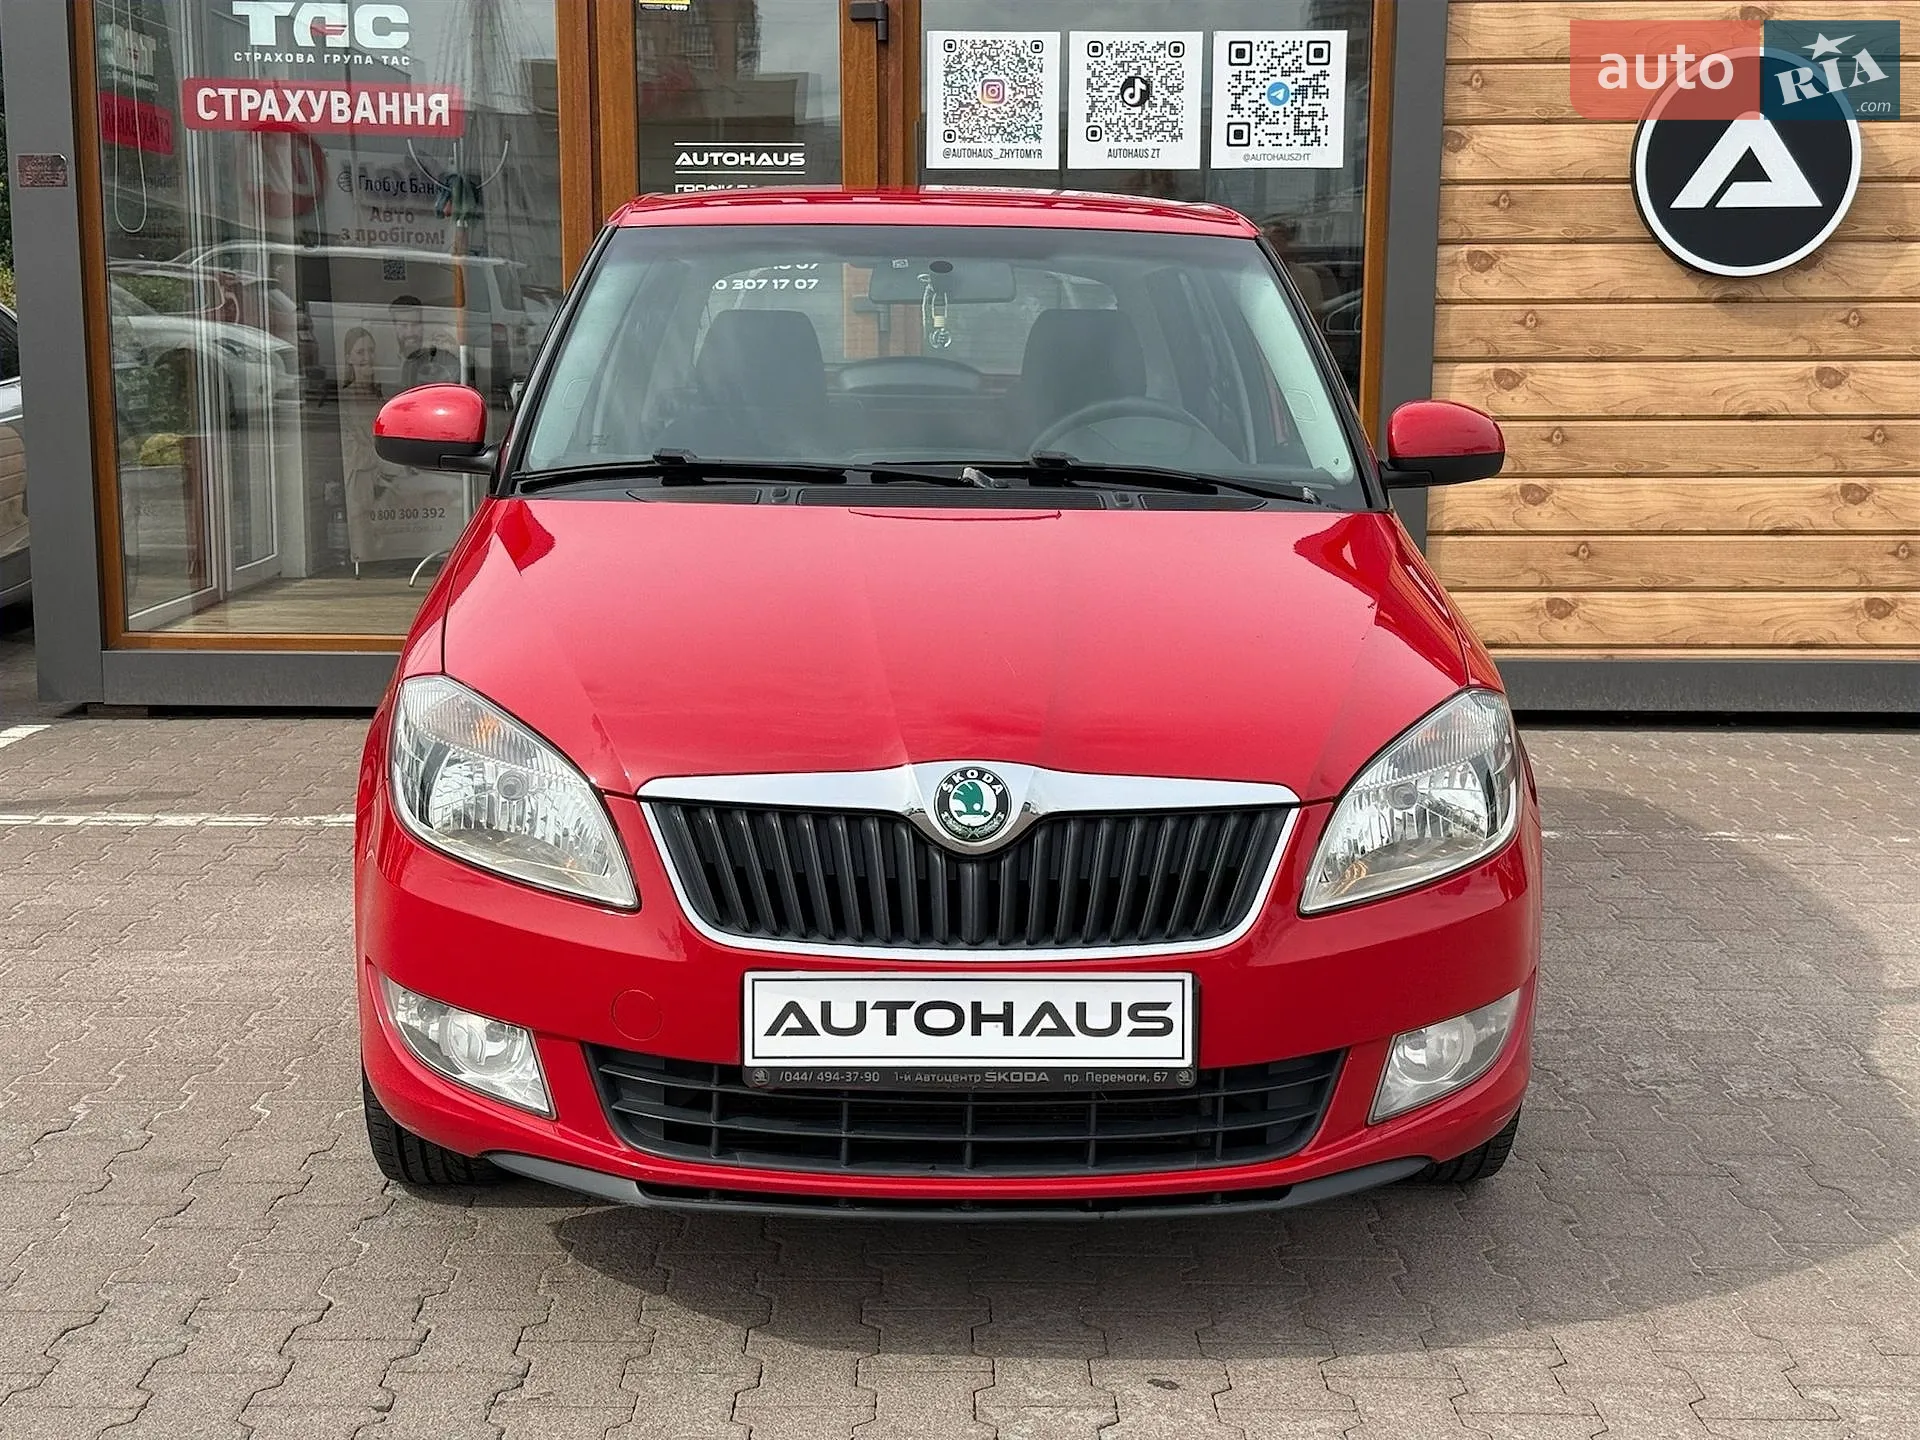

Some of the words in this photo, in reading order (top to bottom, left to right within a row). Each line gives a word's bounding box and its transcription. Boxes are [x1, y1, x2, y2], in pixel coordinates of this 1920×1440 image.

[234, 51, 316, 64] СТРАХОВА
[323, 55, 374, 65] ГРУПА
[381, 55, 411, 66] ТАС
[196, 87, 450, 126] СТРАХУВАННЯ
[675, 152, 806, 166] AUTOHAUS
[943, 148, 1043, 160] @AUTOHAUS_ZHYTOMYR
[1107, 148, 1149, 159] AUTOHAUS
[1150, 148, 1161, 159] ZT
[358, 174, 407, 196] Глобус
[370, 206, 415, 223] Авто
[355, 227, 445, 245] пробігом!
[732, 279, 768, 290] 307
[772, 279, 790, 290] 17
[794, 279, 819, 290] 07
[378, 509, 396, 520] 800
[399, 508, 419, 520] 300
[422, 507, 446, 519] 392
[763, 1000, 1174, 1037] AUTOHAUS
[779, 1071, 813, 1082] /044/
[817, 1071, 880, 1082] 494-37-90
[915, 1072, 982, 1084] Автоцентр
[1085, 1071, 1150, 1084] Перемоги,
[1153, 1071, 1168, 1082] 67
